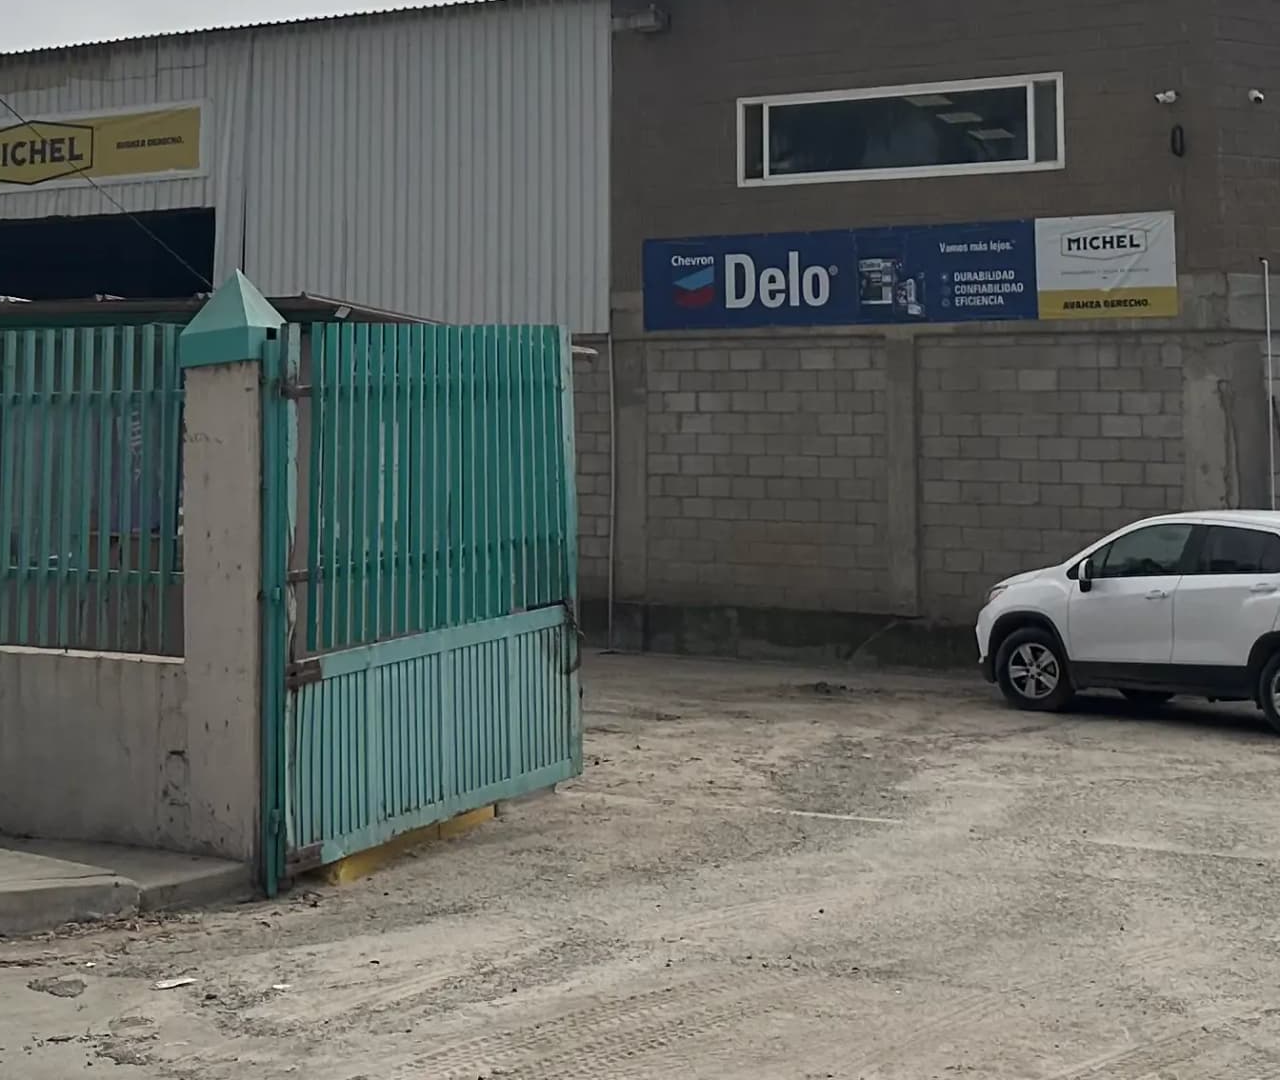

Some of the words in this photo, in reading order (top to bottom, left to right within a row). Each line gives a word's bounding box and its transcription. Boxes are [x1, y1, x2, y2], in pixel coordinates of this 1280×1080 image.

[939, 242, 968, 253] Vamos
[969, 241, 988, 252] más
[1067, 234, 1141, 251] MICHEL
[671, 255, 714, 267] Chevron
[725, 251, 830, 308] Delo
[954, 270, 1015, 281] DURABILIDAD
[954, 282, 1024, 294] CONFIABILIDAD
[955, 295, 1004, 306] EFICIENCIA
